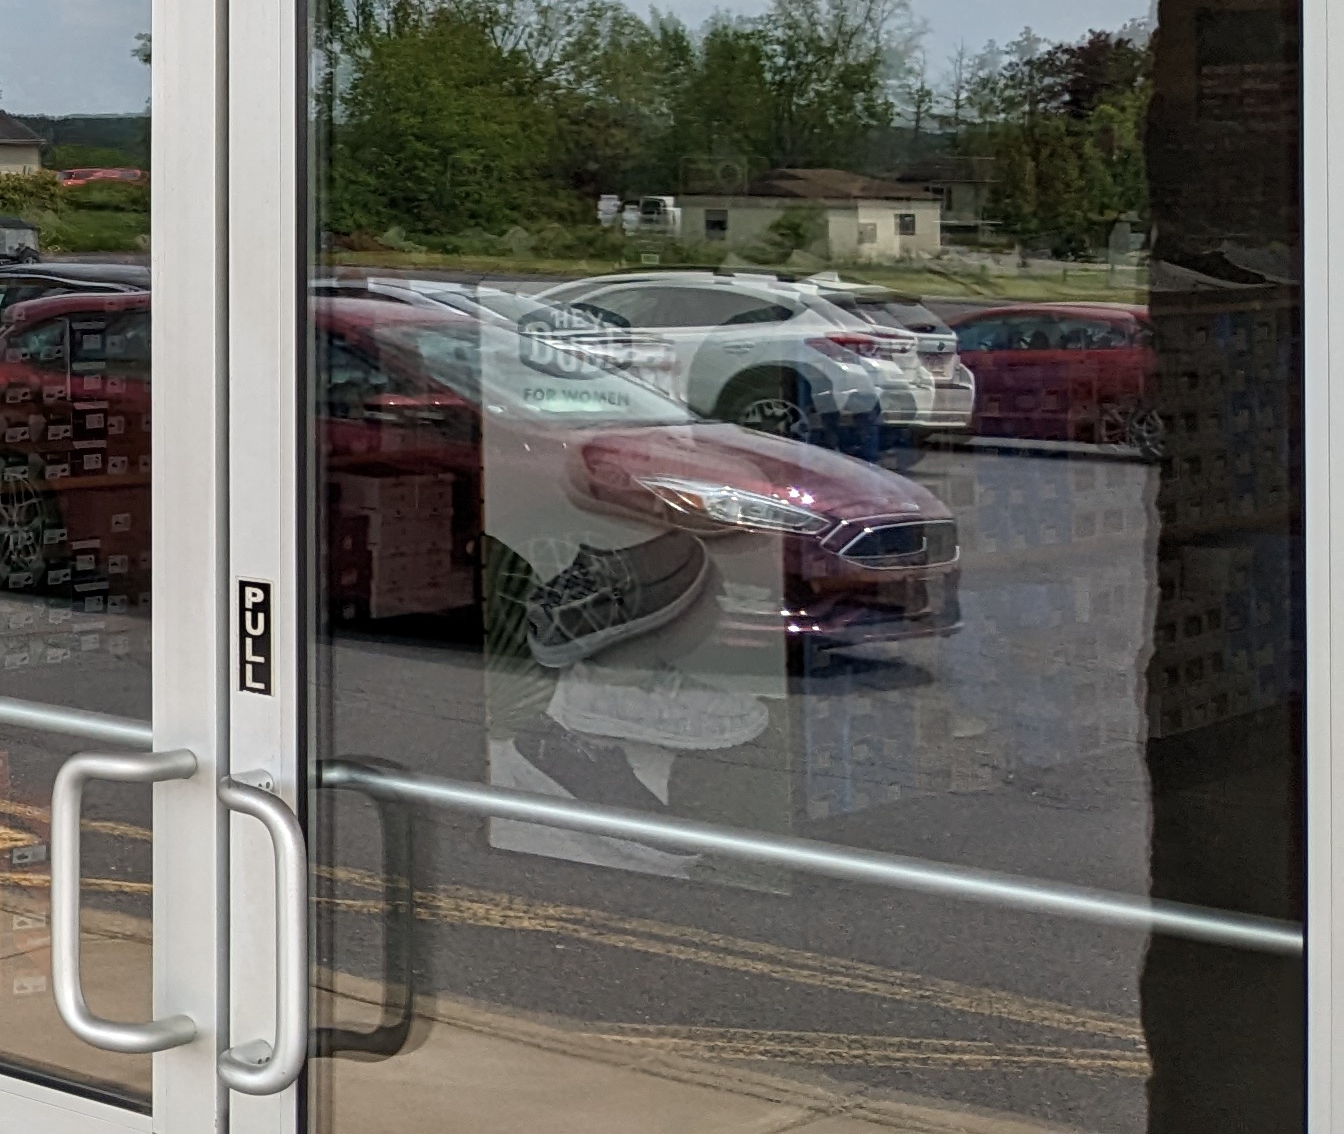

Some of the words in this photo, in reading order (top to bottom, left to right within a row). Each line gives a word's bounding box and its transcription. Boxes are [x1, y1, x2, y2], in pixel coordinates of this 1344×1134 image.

[523, 387, 557, 402] FOR
[563, 389, 630, 407] WOMEN
[244, 586, 265, 690] PULL
